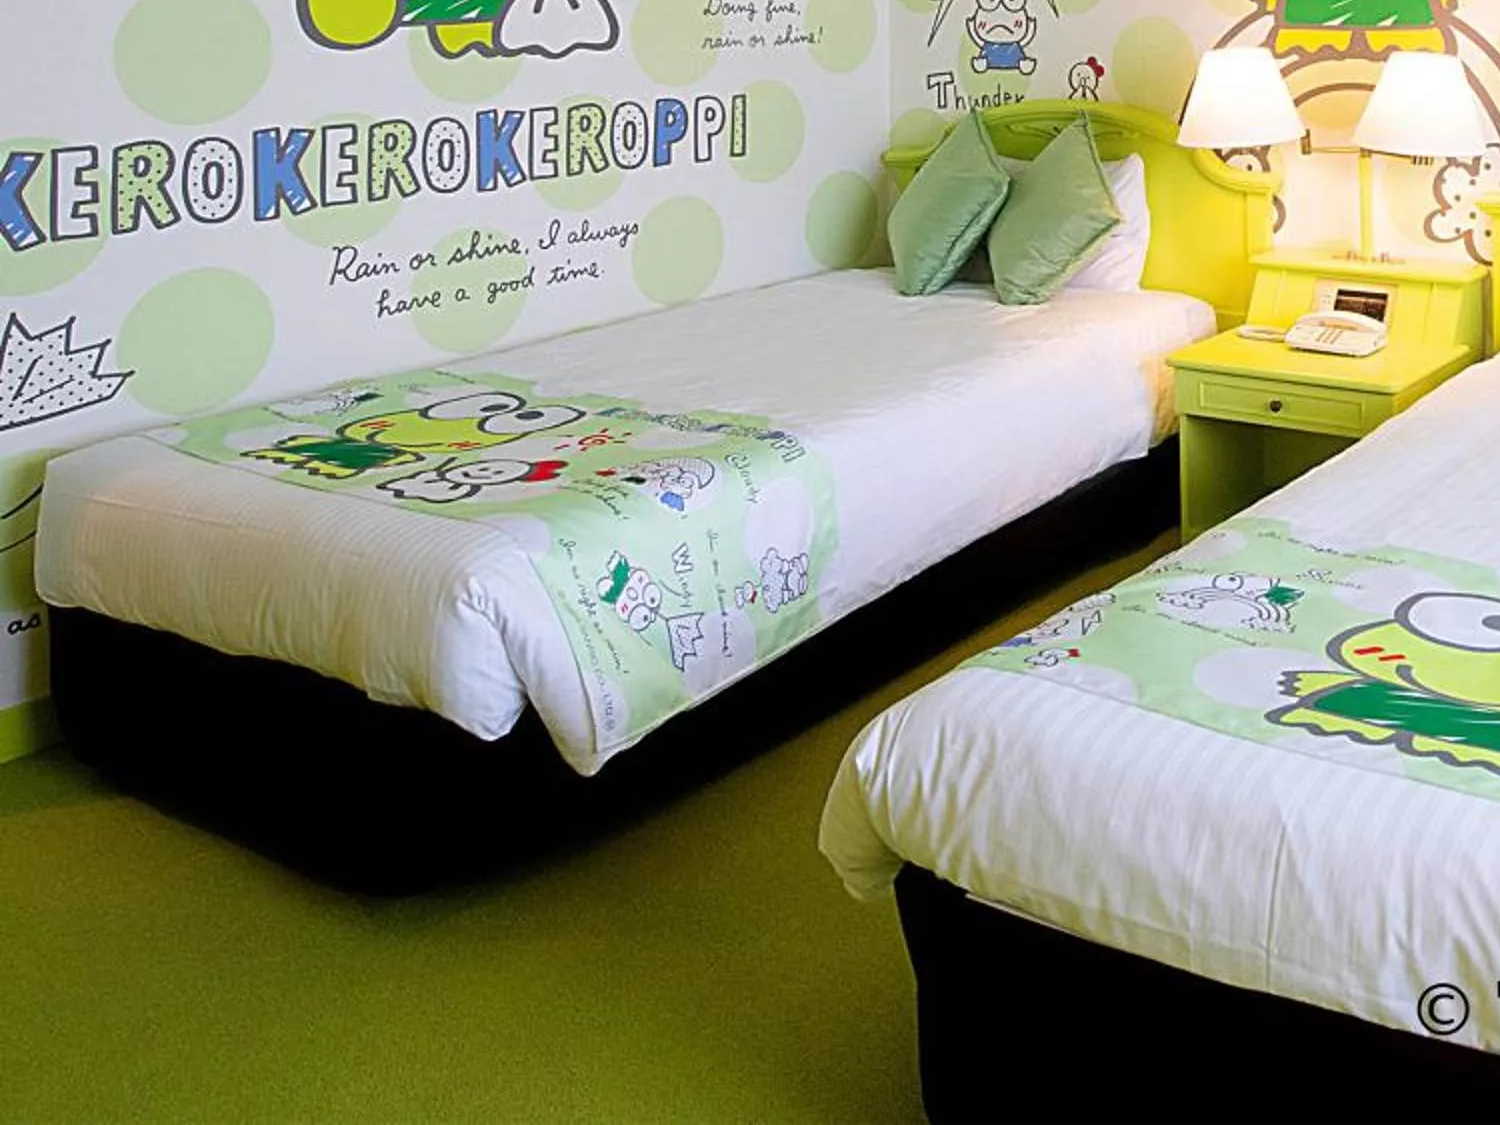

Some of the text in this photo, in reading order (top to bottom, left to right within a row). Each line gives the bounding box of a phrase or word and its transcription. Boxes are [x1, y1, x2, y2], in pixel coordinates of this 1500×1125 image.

[701, 23, 823, 50] rain or shine!
[926, 71, 1026, 111] Thunder
[0, 93, 748, 252] KEROKEROKEROPPI
[328, 245, 401, 286] Rain
[408, 252, 438, 271] or
[538, 218, 561, 251] I
[567, 218, 639, 249] always
[375, 288, 442, 319] have
[454, 288, 471, 302] a
[486, 265, 536, 305] good
[7, 612, 41, 636] as
